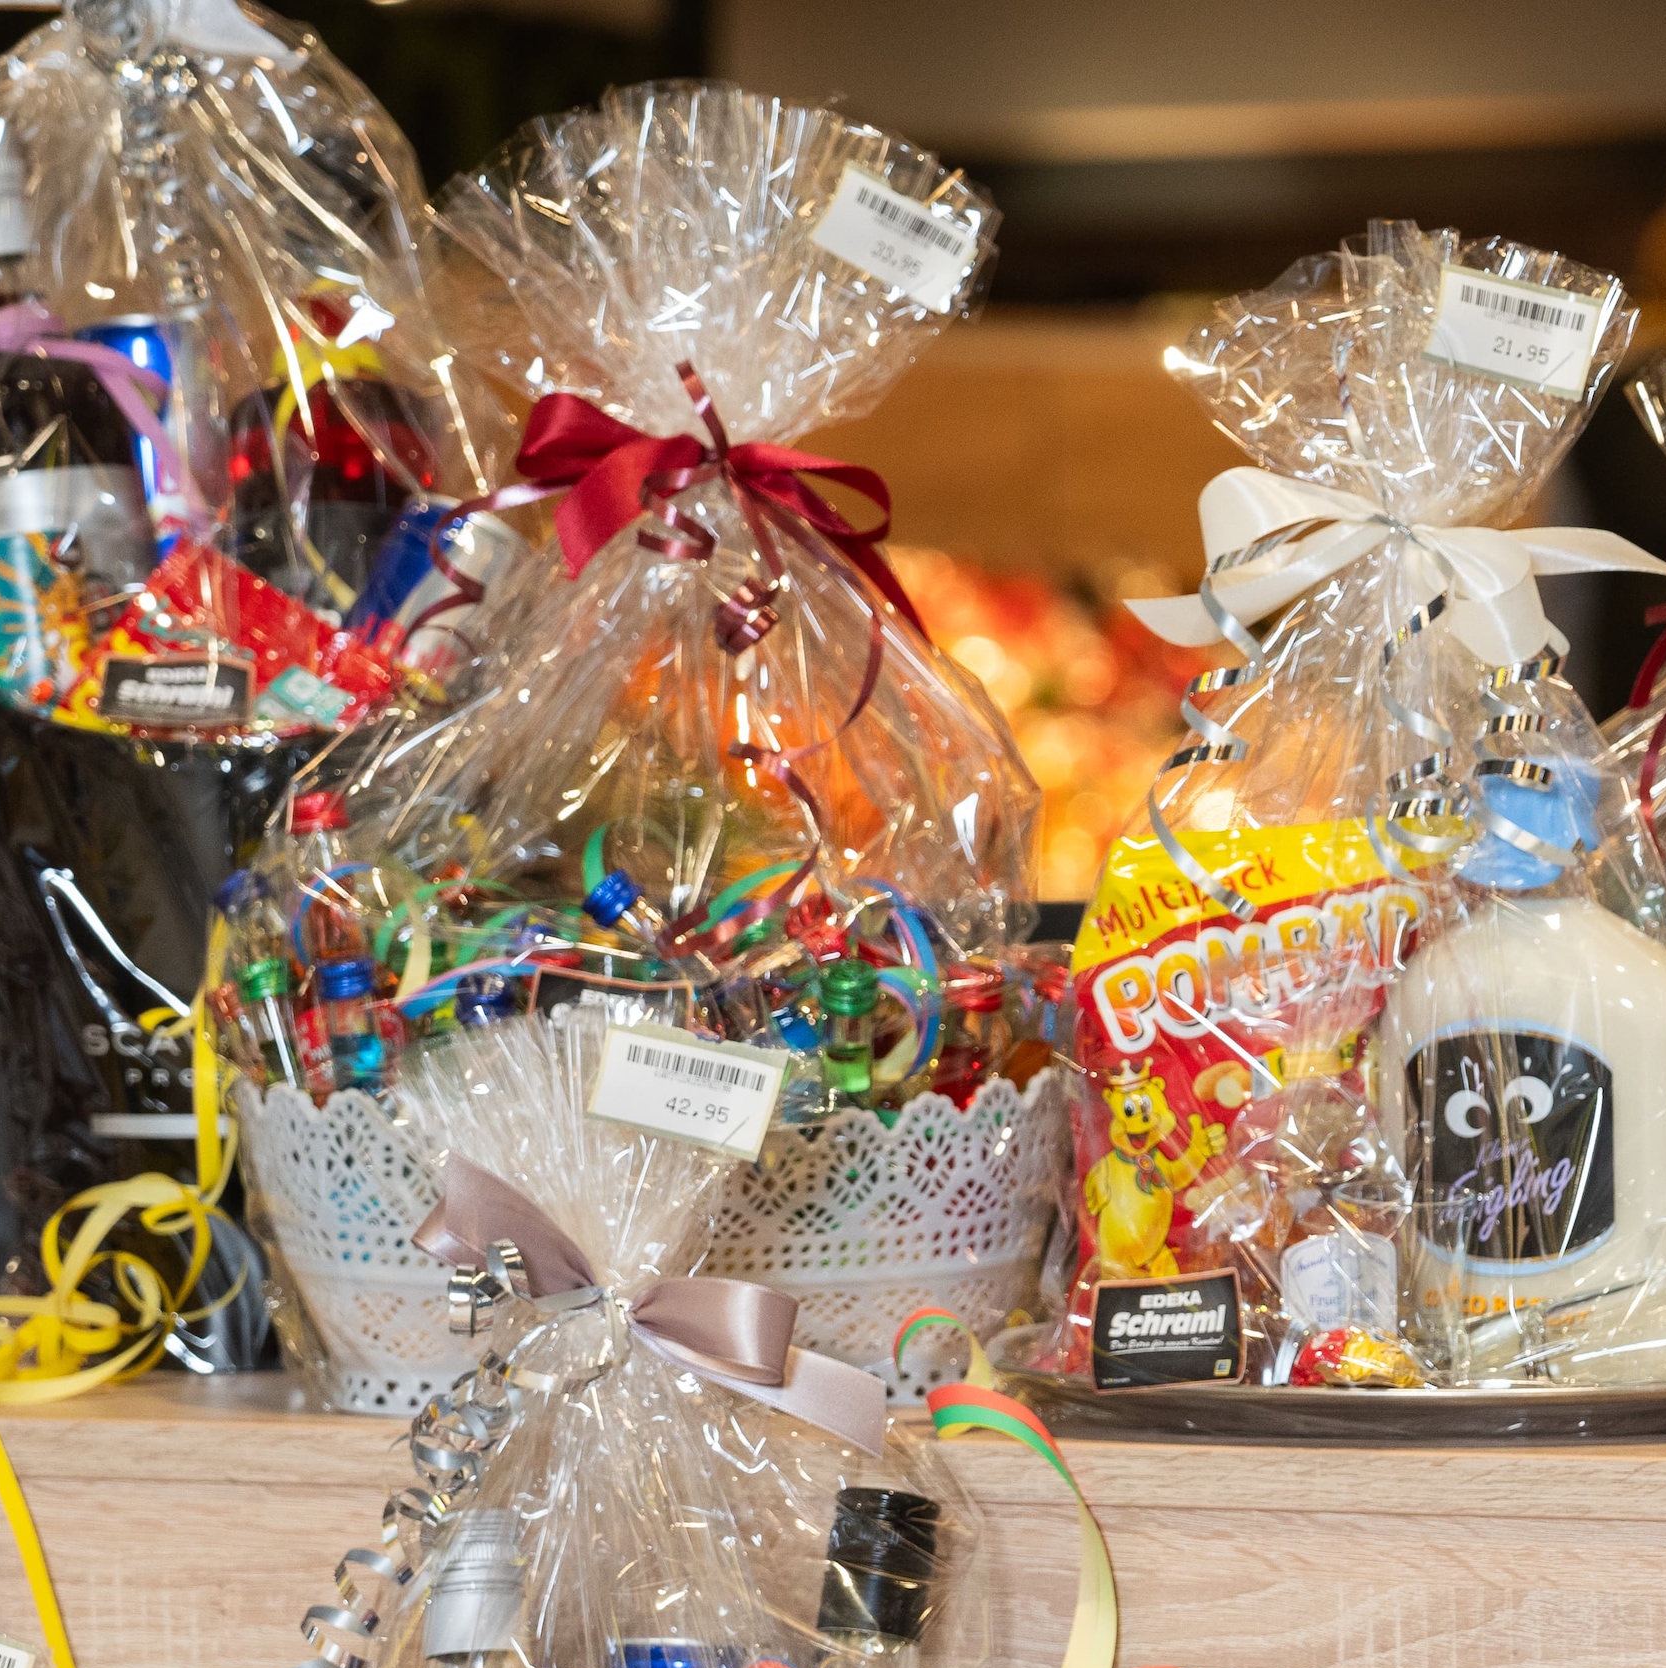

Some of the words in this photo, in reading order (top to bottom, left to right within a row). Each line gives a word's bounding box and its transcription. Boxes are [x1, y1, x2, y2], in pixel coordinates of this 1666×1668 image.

[1490, 336, 1551, 365] 21,95
[665, 1096, 730, 1124] 42,95
[1139, 1290, 1203, 1309] EDEKA
[1108, 1304, 1226, 1338] Schraml
